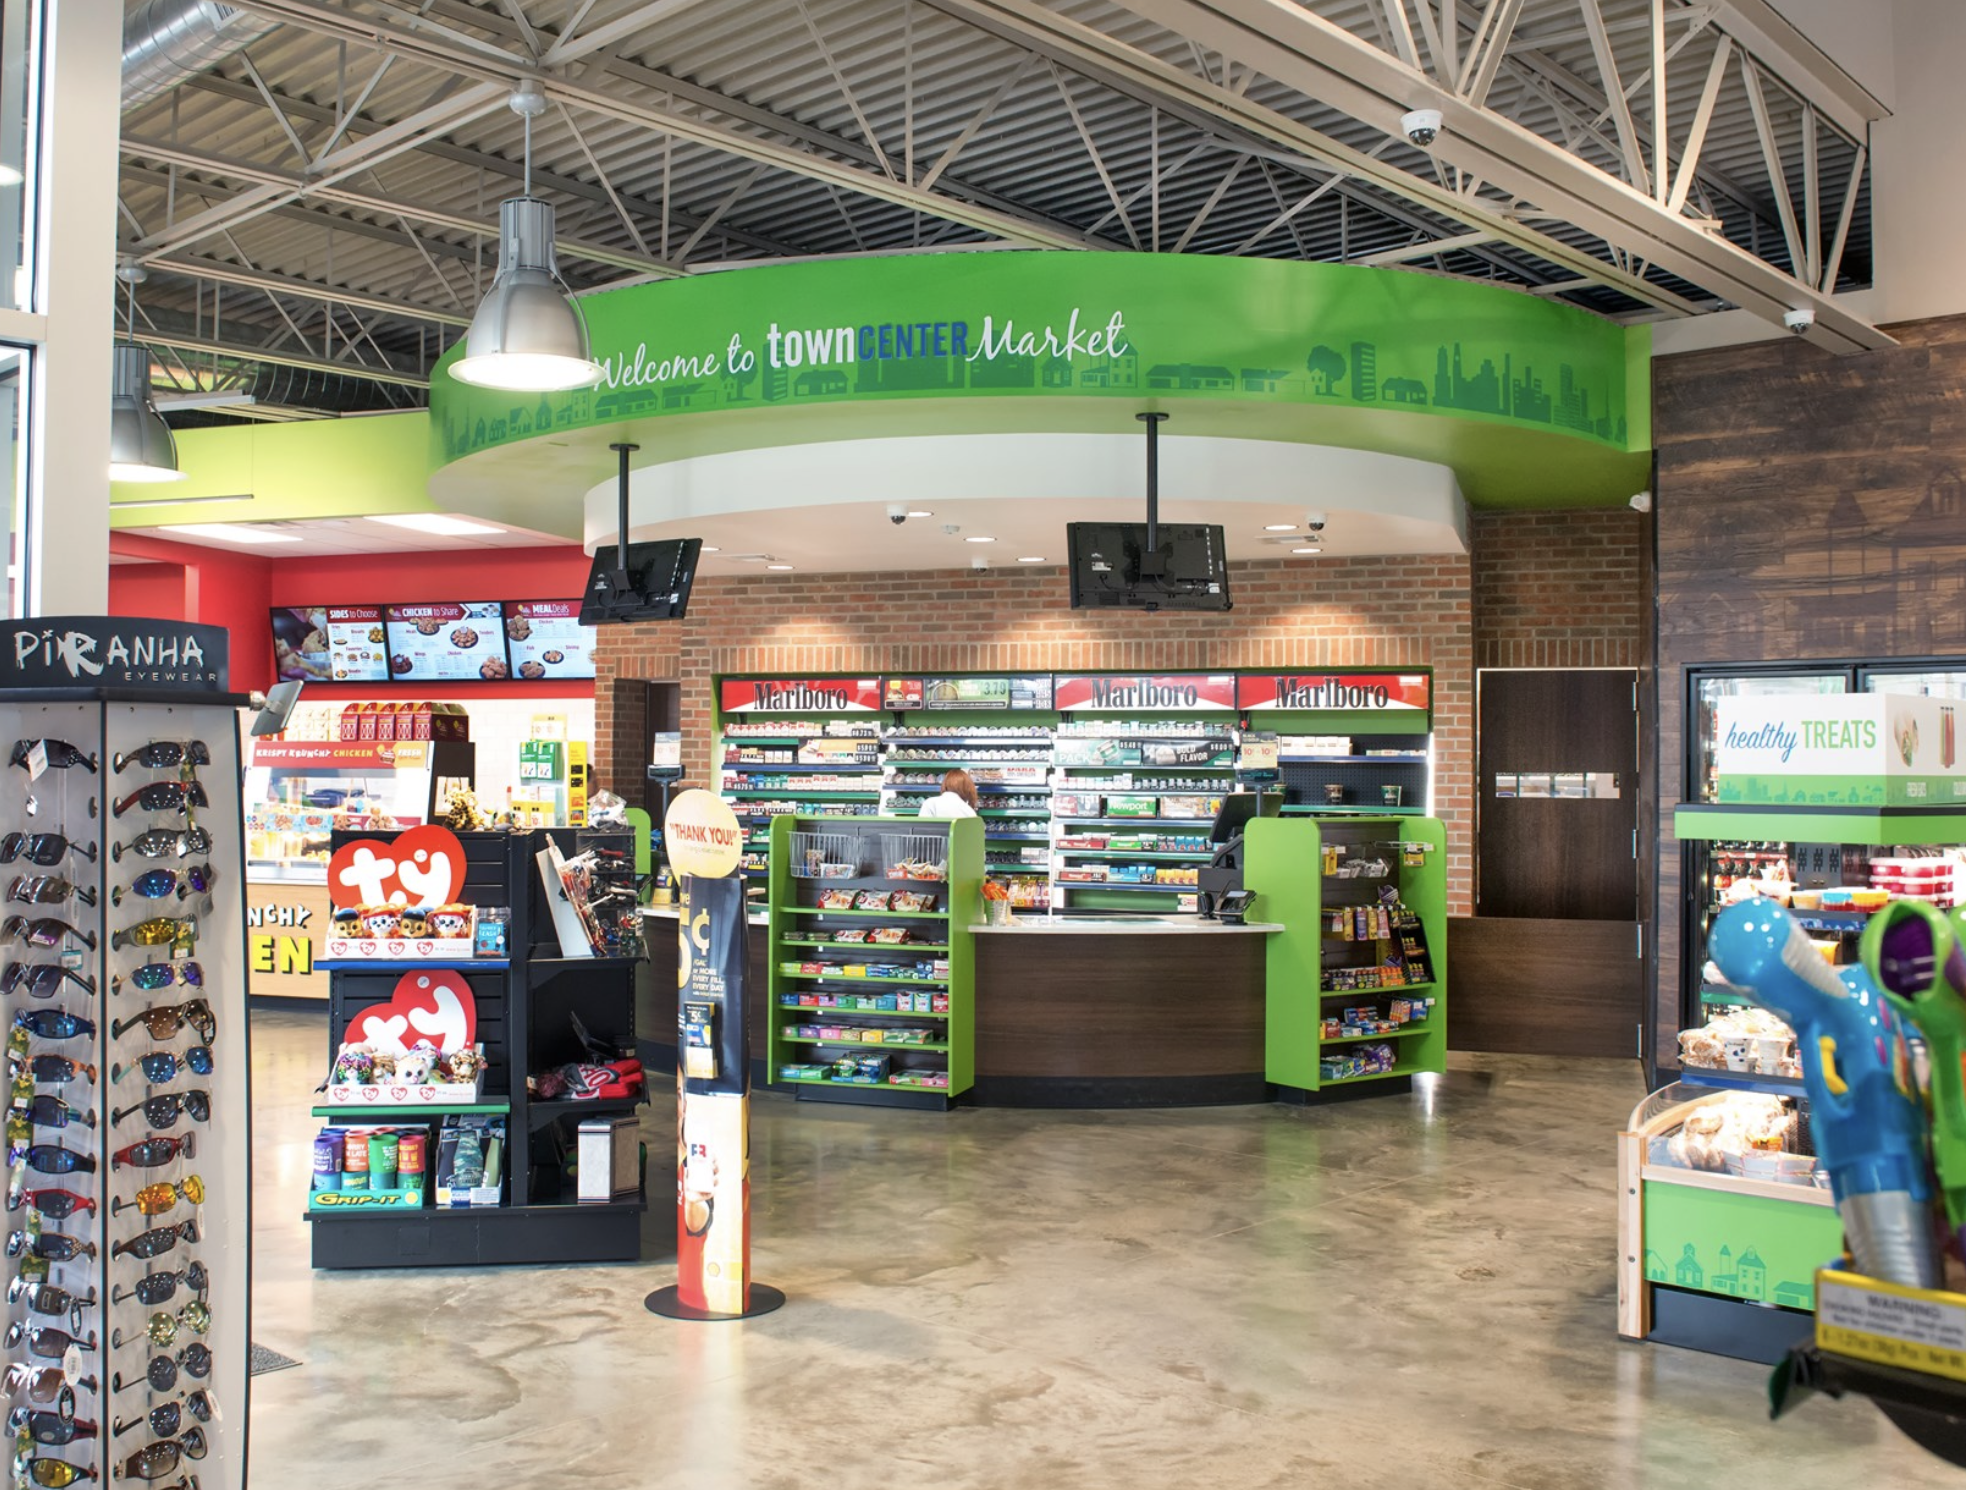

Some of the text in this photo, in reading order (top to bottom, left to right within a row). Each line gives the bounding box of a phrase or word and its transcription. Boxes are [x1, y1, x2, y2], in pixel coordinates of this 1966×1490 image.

[593, 342, 720, 392] Welcome
[727, 333, 755, 374] to
[965, 307, 1129, 362] Market
[330, 610, 378, 618] SIDES to Choose
[402, 607, 458, 616] CHICKEN to Share
[124, 671, 217, 682] EYEWEAR
[754, 682, 847, 710] Marlboro
[1091, 678, 1198, 708] Marlboro
[1276, 677, 1388, 708] Marlboro
[1724, 720, 1876, 763] healthy TREATS
[256, 749, 422, 759] KRISPY KRUNCHY CHICKEN FRESH
[1059, 753, 1091, 763] PACK
[1180, 752, 1208, 763] FLAVOR
[251, 934, 310, 974] EN
